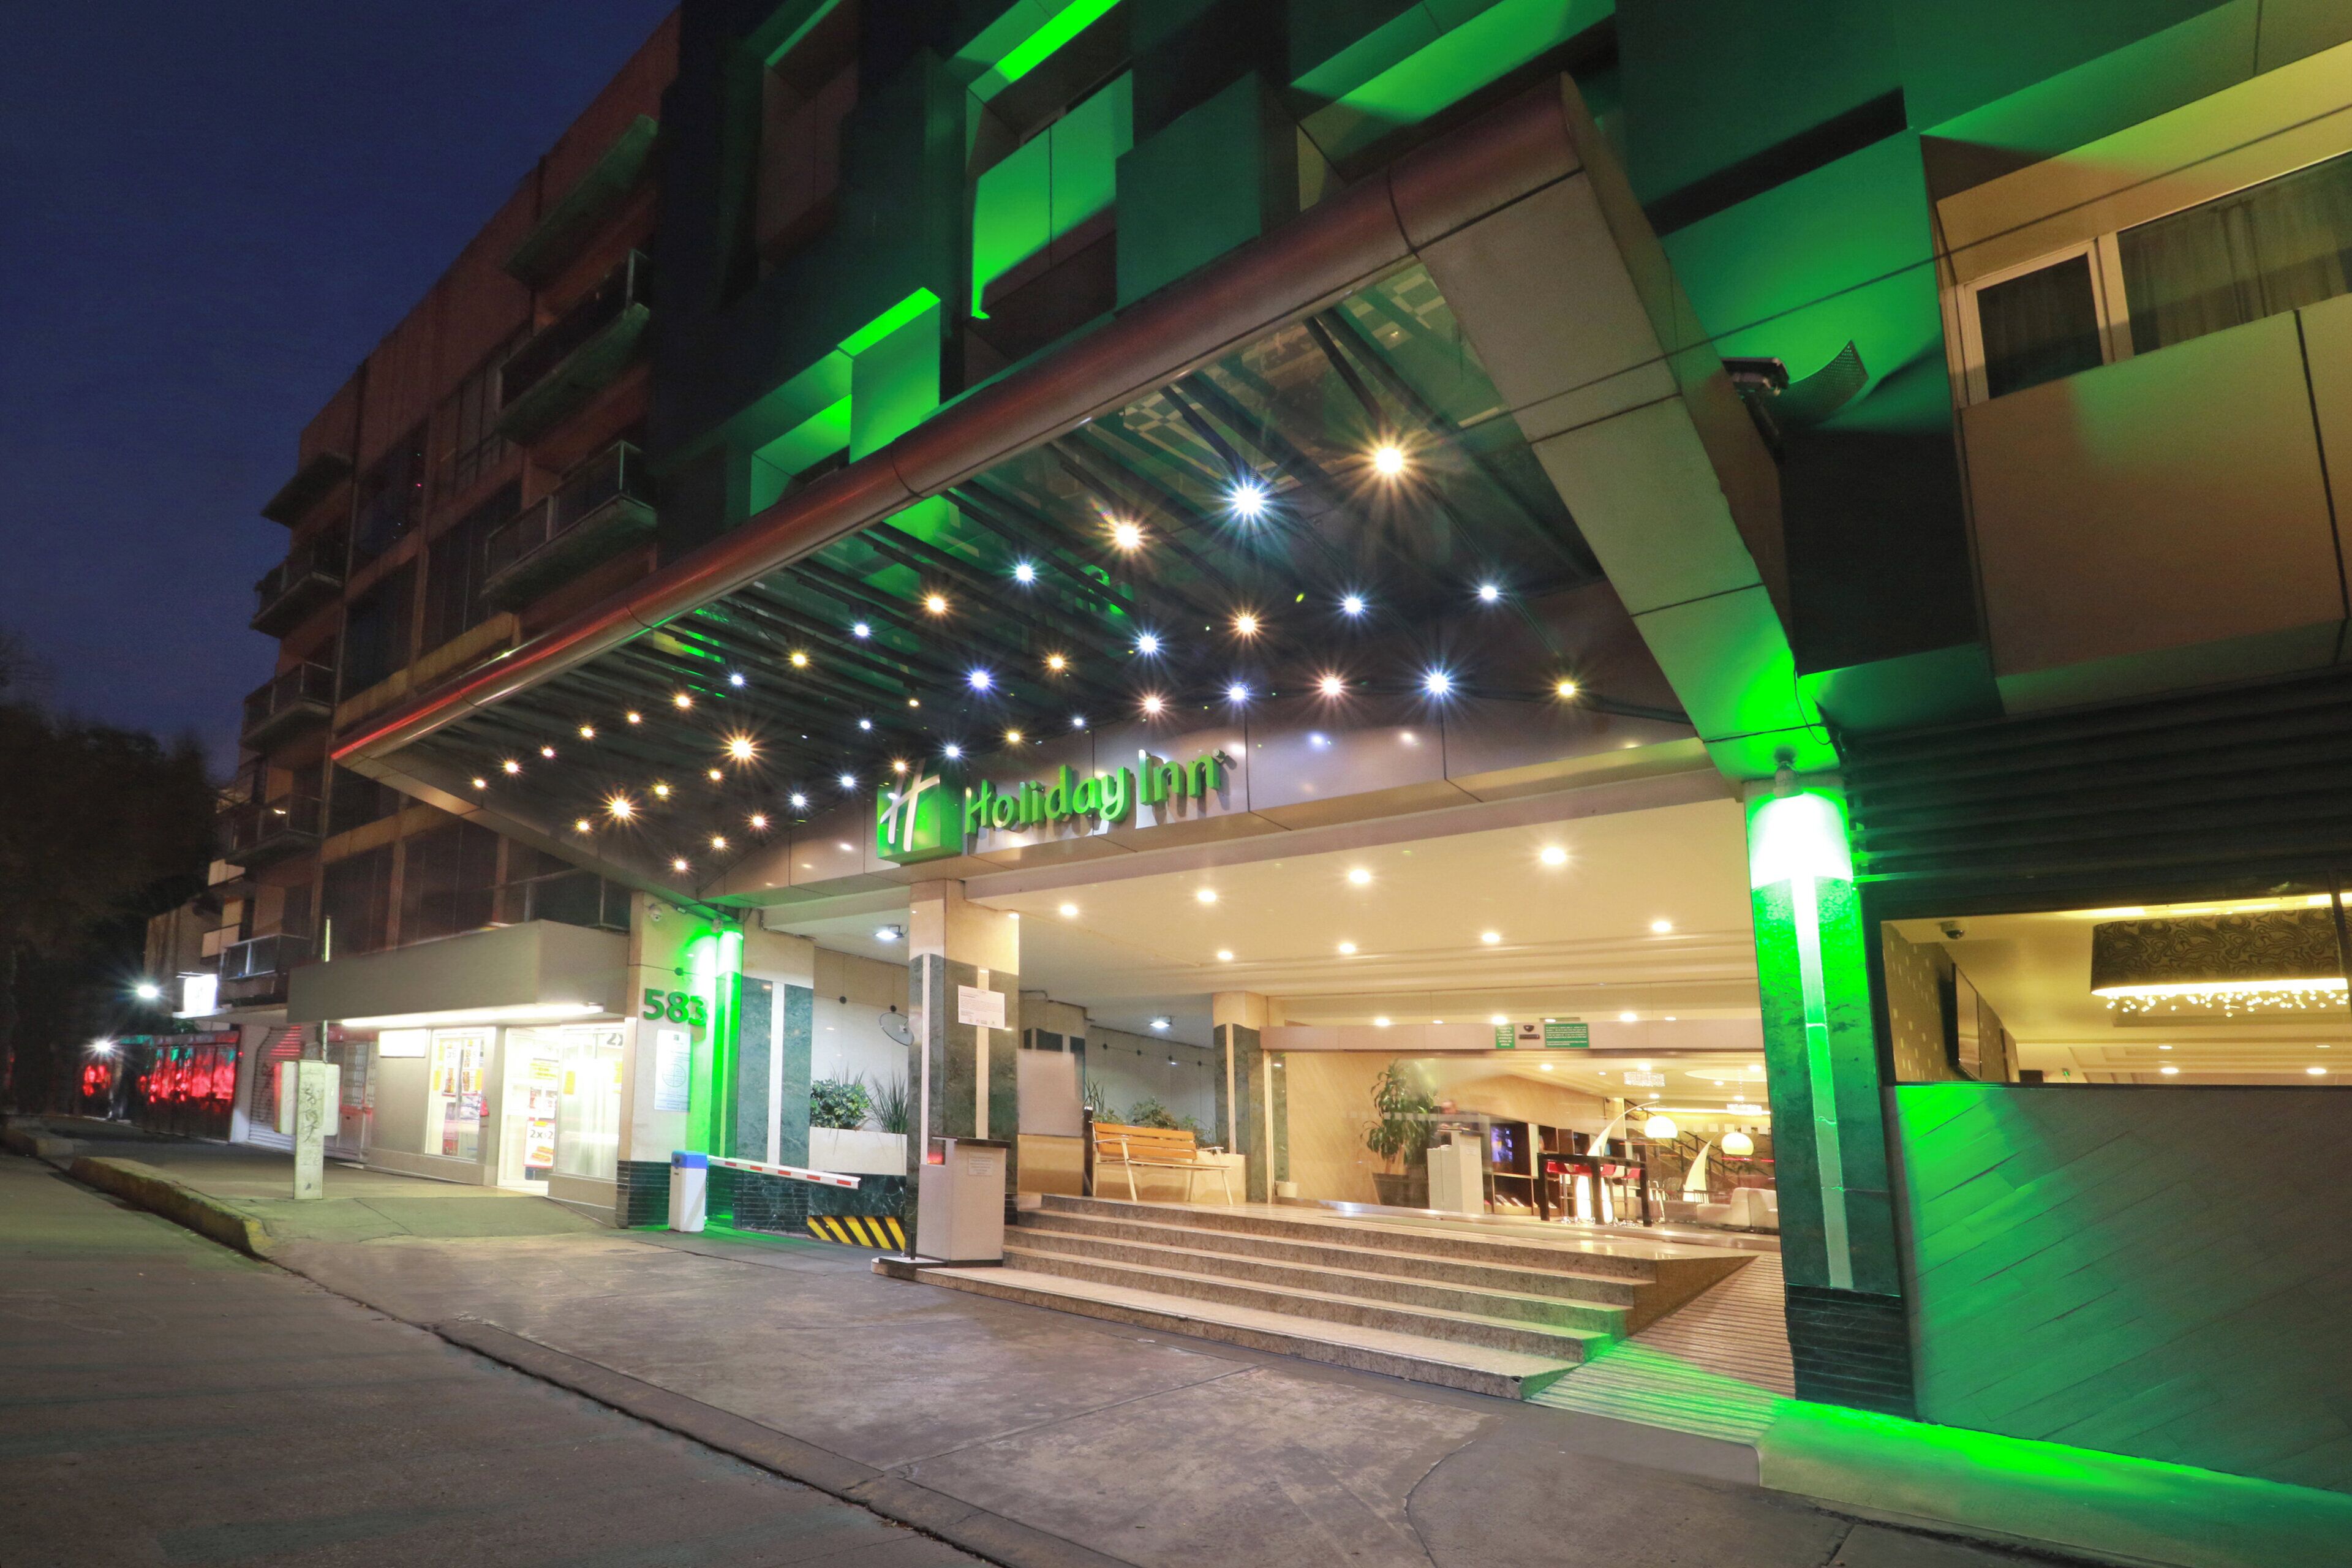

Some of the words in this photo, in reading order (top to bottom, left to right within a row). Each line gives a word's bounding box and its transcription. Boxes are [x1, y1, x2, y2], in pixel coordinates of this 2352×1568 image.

[965, 764, 1131, 835] Holiday
[1137, 748, 1221, 806] Inn
[643, 988, 709, 1027] 583
